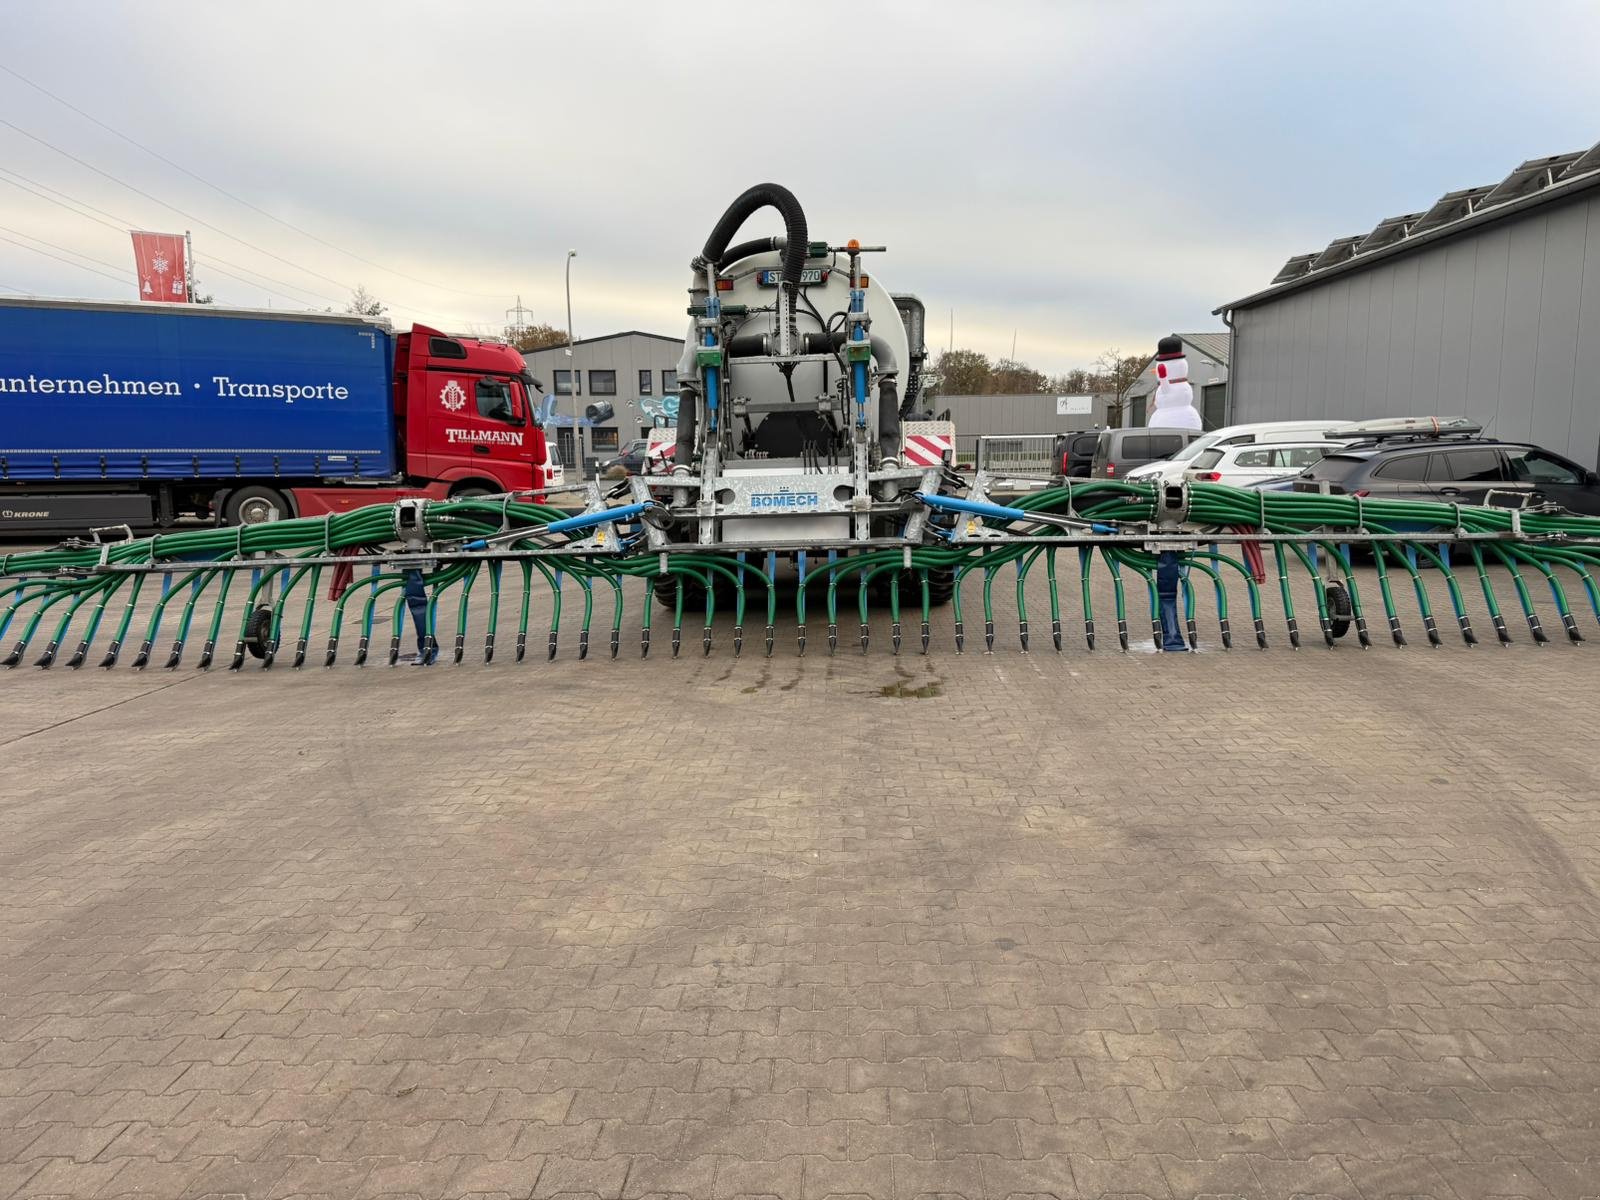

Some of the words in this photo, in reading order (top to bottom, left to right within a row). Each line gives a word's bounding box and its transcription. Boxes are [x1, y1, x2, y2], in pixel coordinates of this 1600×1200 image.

[212, 376, 349, 403] Transporte
[446, 428, 524, 446] TILLMANN
[751, 495, 818, 507] BOMECH
